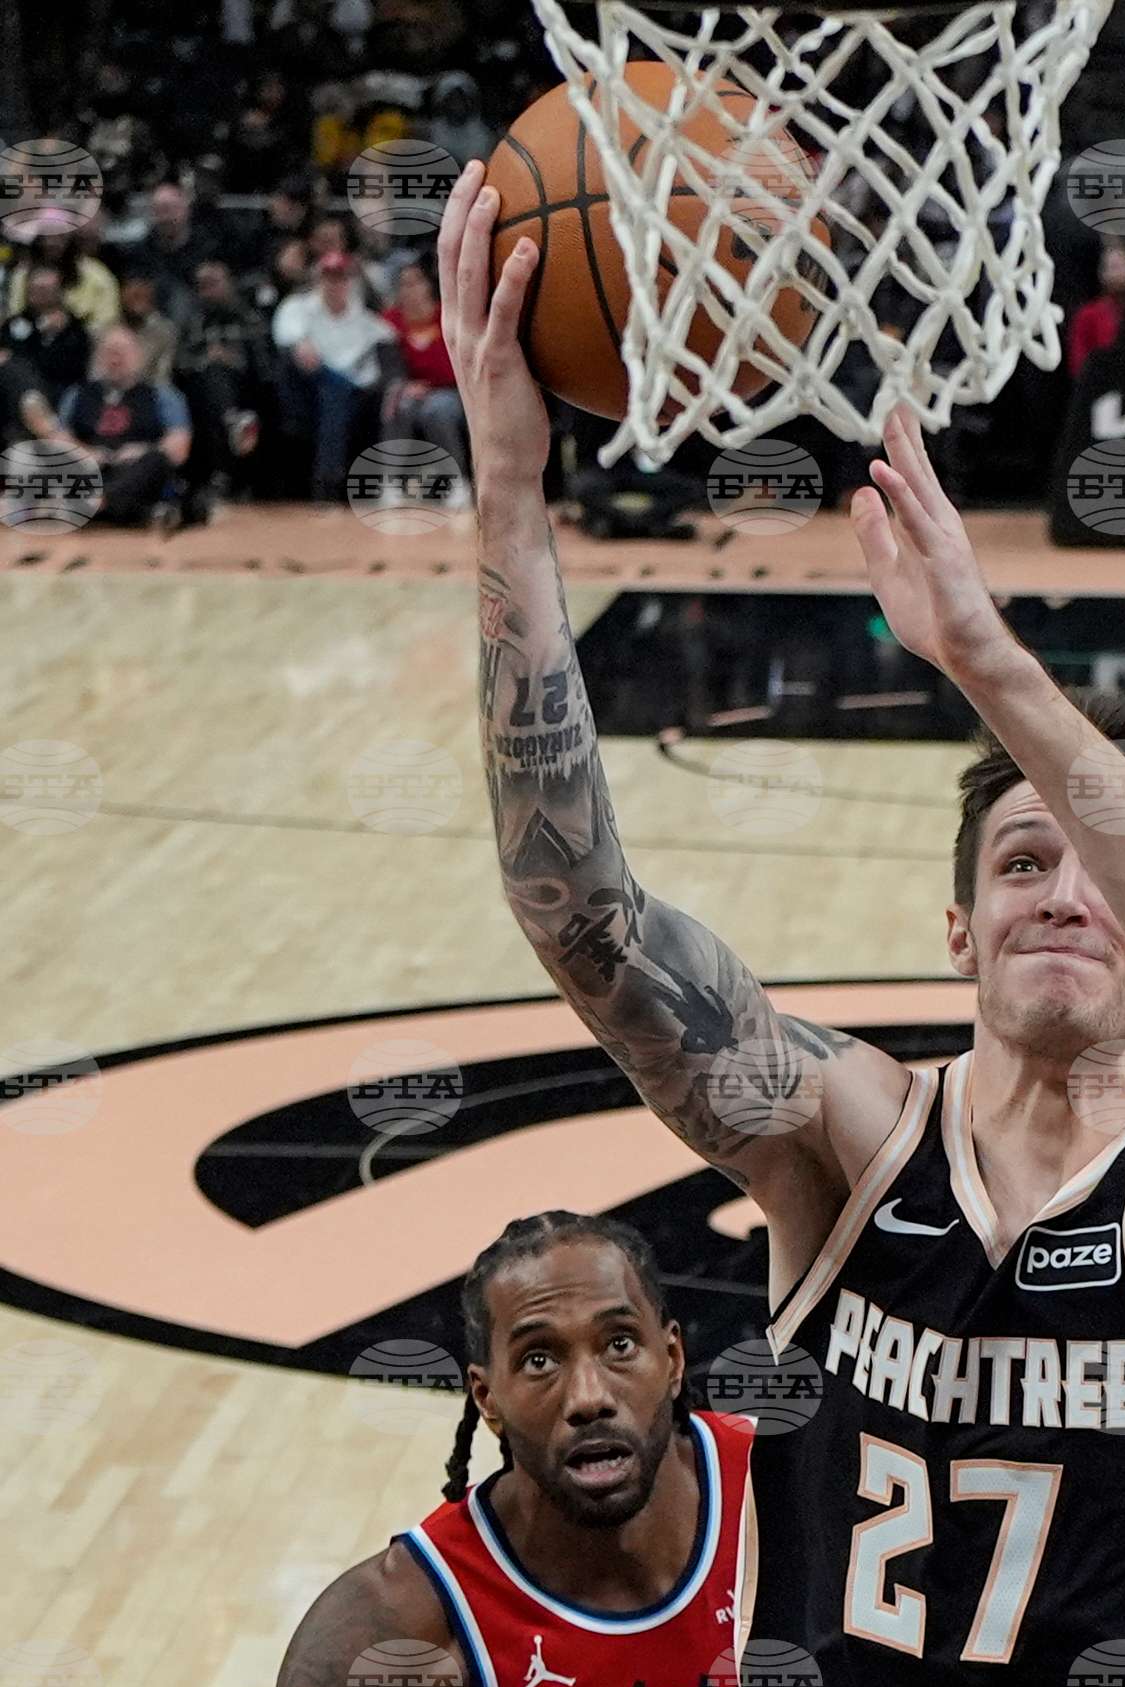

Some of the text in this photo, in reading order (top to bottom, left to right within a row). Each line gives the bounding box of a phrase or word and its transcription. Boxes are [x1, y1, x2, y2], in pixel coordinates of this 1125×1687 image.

[509, 671, 569, 727] 27
[1027, 1243, 1113, 1274] paze
[843, 1431, 1064, 1664] 27
